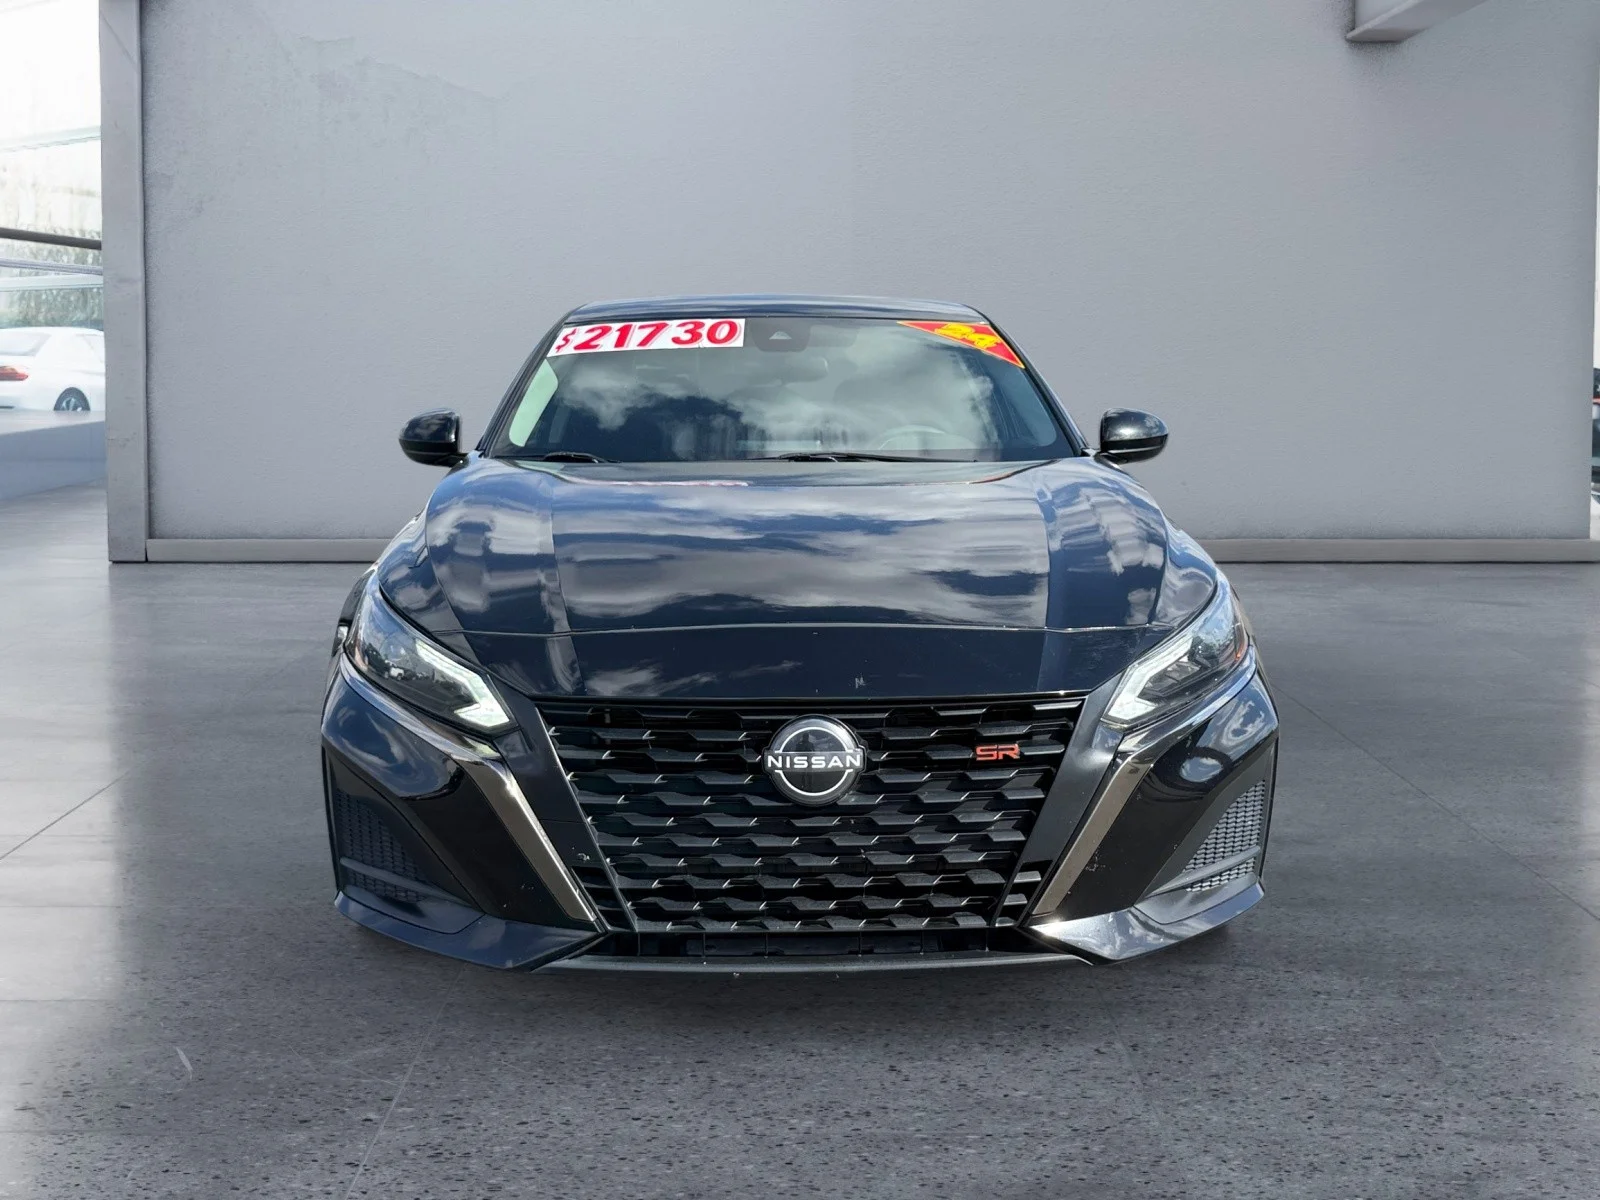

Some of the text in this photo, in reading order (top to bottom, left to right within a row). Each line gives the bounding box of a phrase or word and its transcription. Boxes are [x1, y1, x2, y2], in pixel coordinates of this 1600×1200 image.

[555, 319, 740, 354] $21730
[975, 743, 1020, 761] SR
[767, 754, 862, 769] NISSAN
